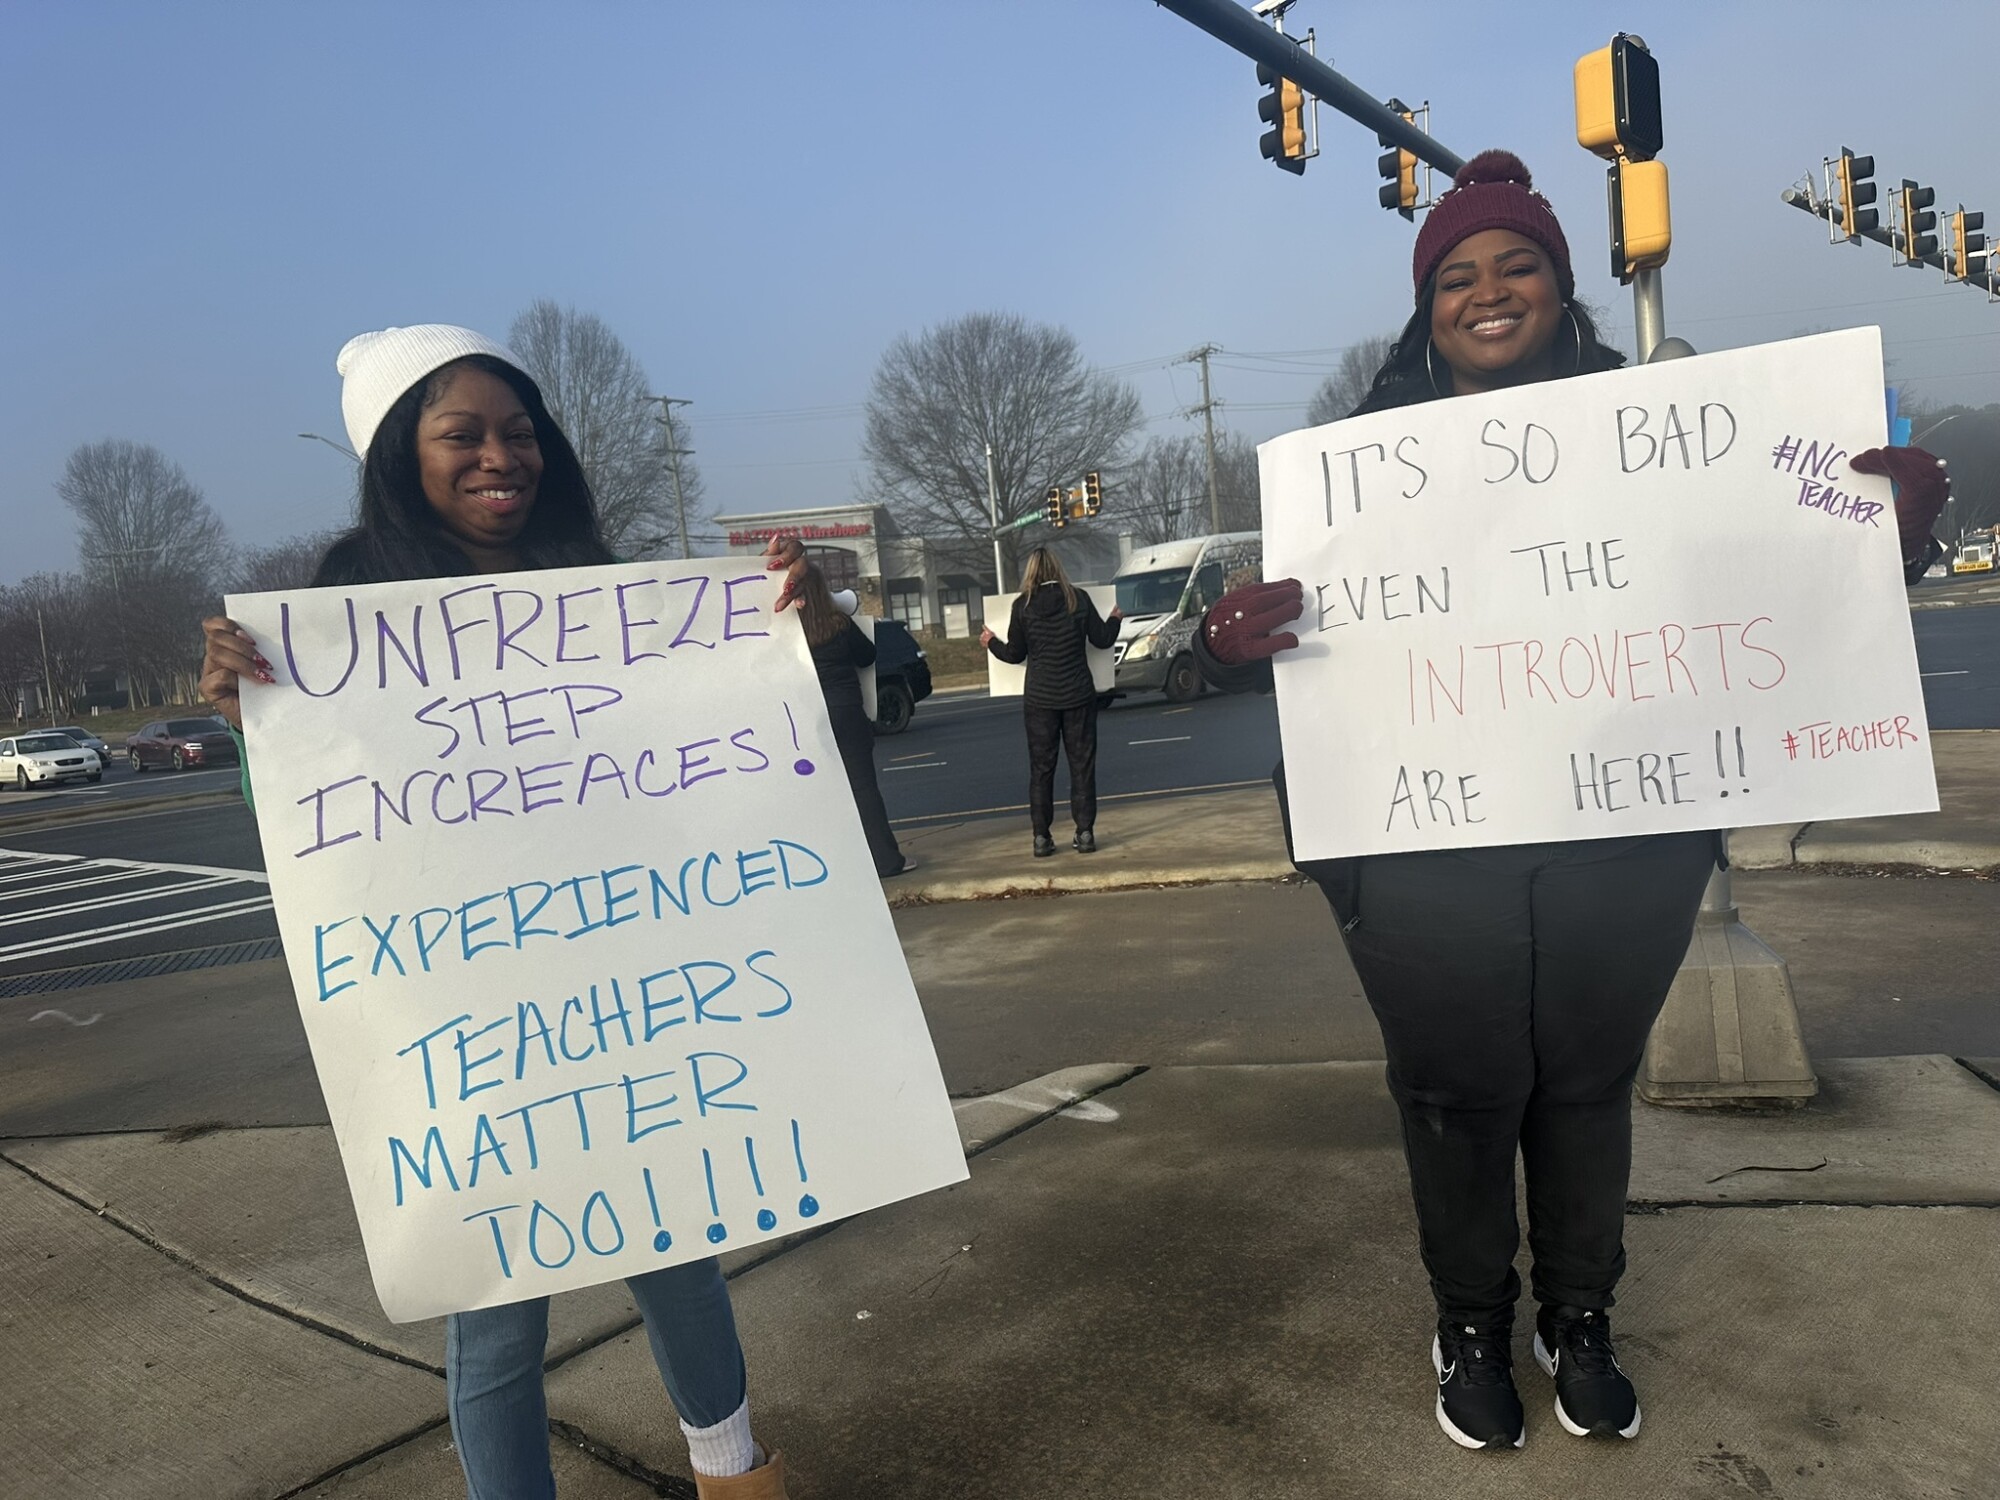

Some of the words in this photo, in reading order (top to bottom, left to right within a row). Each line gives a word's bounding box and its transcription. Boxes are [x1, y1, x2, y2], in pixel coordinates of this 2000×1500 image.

[1321, 435, 1428, 527] IT'S
[1481, 418, 1559, 484] SO
[1616, 402, 1737, 474] BAD
[1771, 434, 1848, 481] #NC
[1797, 476, 1885, 528] TEACHER
[801, 522, 873, 538] Warehouse
[281, 574, 770, 697] UNFREEZE
[1316, 566, 1450, 632] EVEN
[1511, 538, 1630, 597] THE
[415, 685, 623, 758] STEP
[1408, 616, 1786, 726] INTROVERTS
[1386, 765, 1487, 833] ARE
[1570, 725, 1751, 812] HERE!!
[1781, 715, 1919, 761] #TEACHER
[315, 840, 828, 1002] EXPERIENCED
[396, 950, 793, 1109] TEACHERS
[388, 1052, 758, 1206] MATTER
[463, 1118, 820, 1279] TOO!!!!
